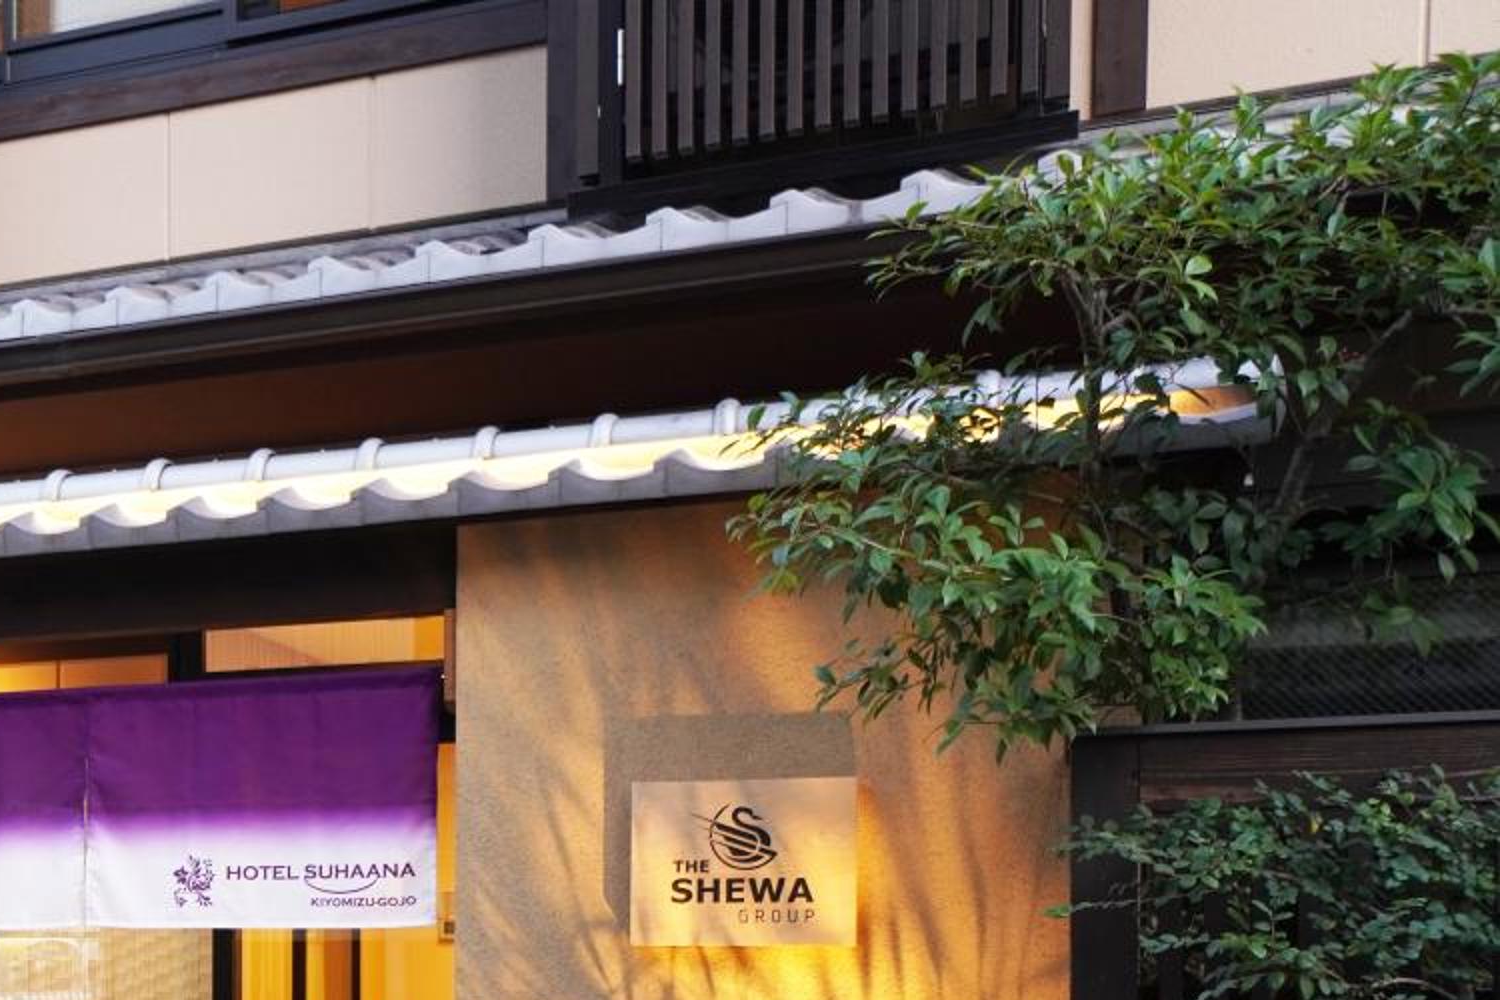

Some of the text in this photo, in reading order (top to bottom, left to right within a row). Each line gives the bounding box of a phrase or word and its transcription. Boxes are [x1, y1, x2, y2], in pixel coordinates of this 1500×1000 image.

[226, 863, 417, 881] HOTEL SUHAANA
[673, 860, 709, 873] THE
[671, 877, 814, 904] SHEWA
[310, 896, 417, 908] KIYOMIZU-GOJO
[738, 909, 816, 924] GROUP
